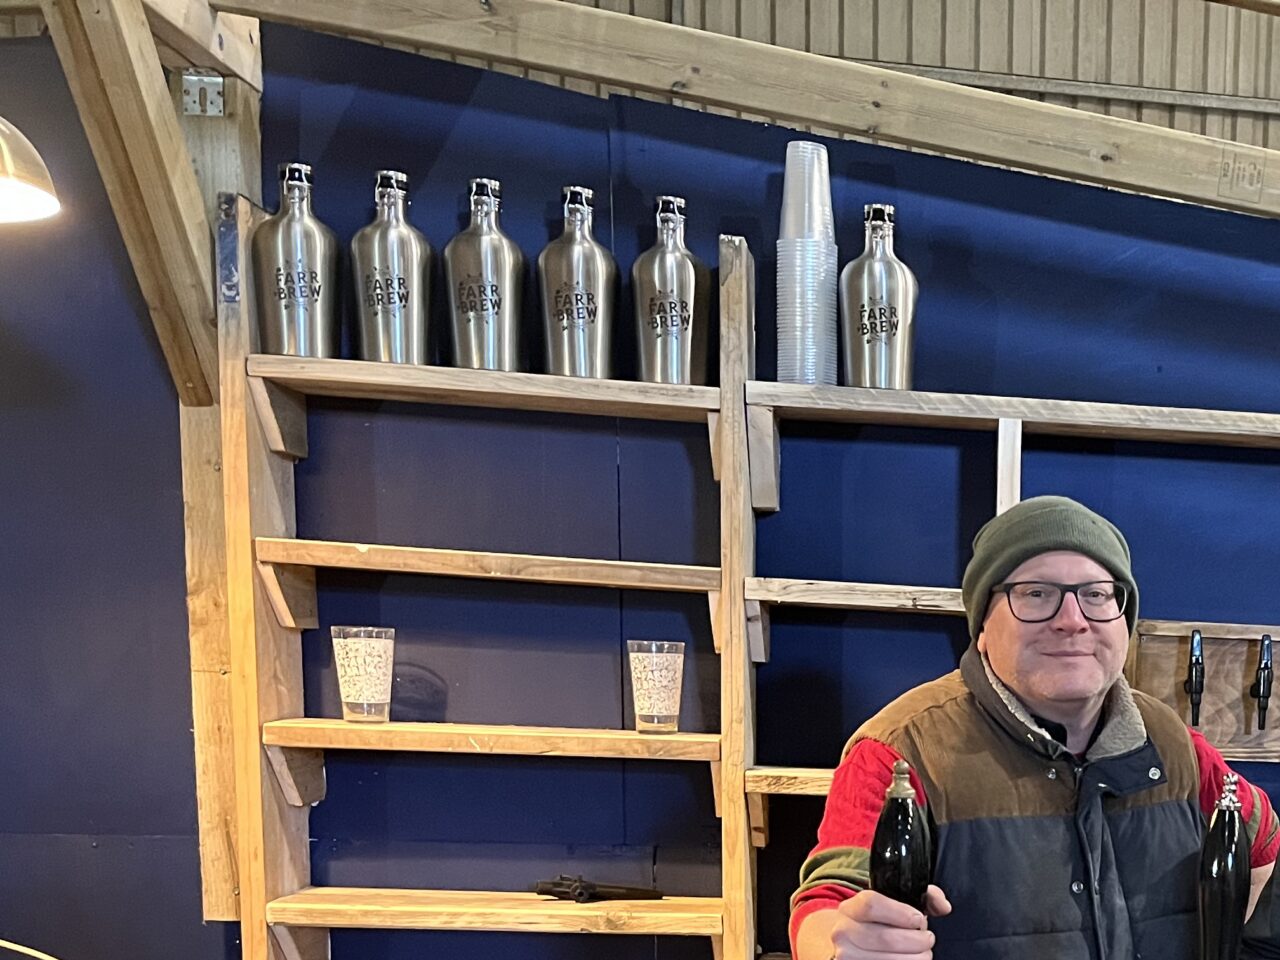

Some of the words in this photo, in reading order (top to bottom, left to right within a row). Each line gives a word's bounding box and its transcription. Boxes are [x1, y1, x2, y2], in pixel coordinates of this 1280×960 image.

[276, 271, 320, 286] FARR
[366, 277, 408, 293] FARR
[277, 285, 321, 299] BREW
[457, 284, 499, 299] FARR
[367, 291, 410, 308] BREW
[459, 298, 501, 314] BREW
[554, 293, 595, 309] FARR
[556, 306, 598, 321] BREW
[650, 301, 689, 316] FARR
[859, 307, 897, 322] FARR
[651, 314, 691, 329] BREW
[860, 320, 899, 335] BREW
